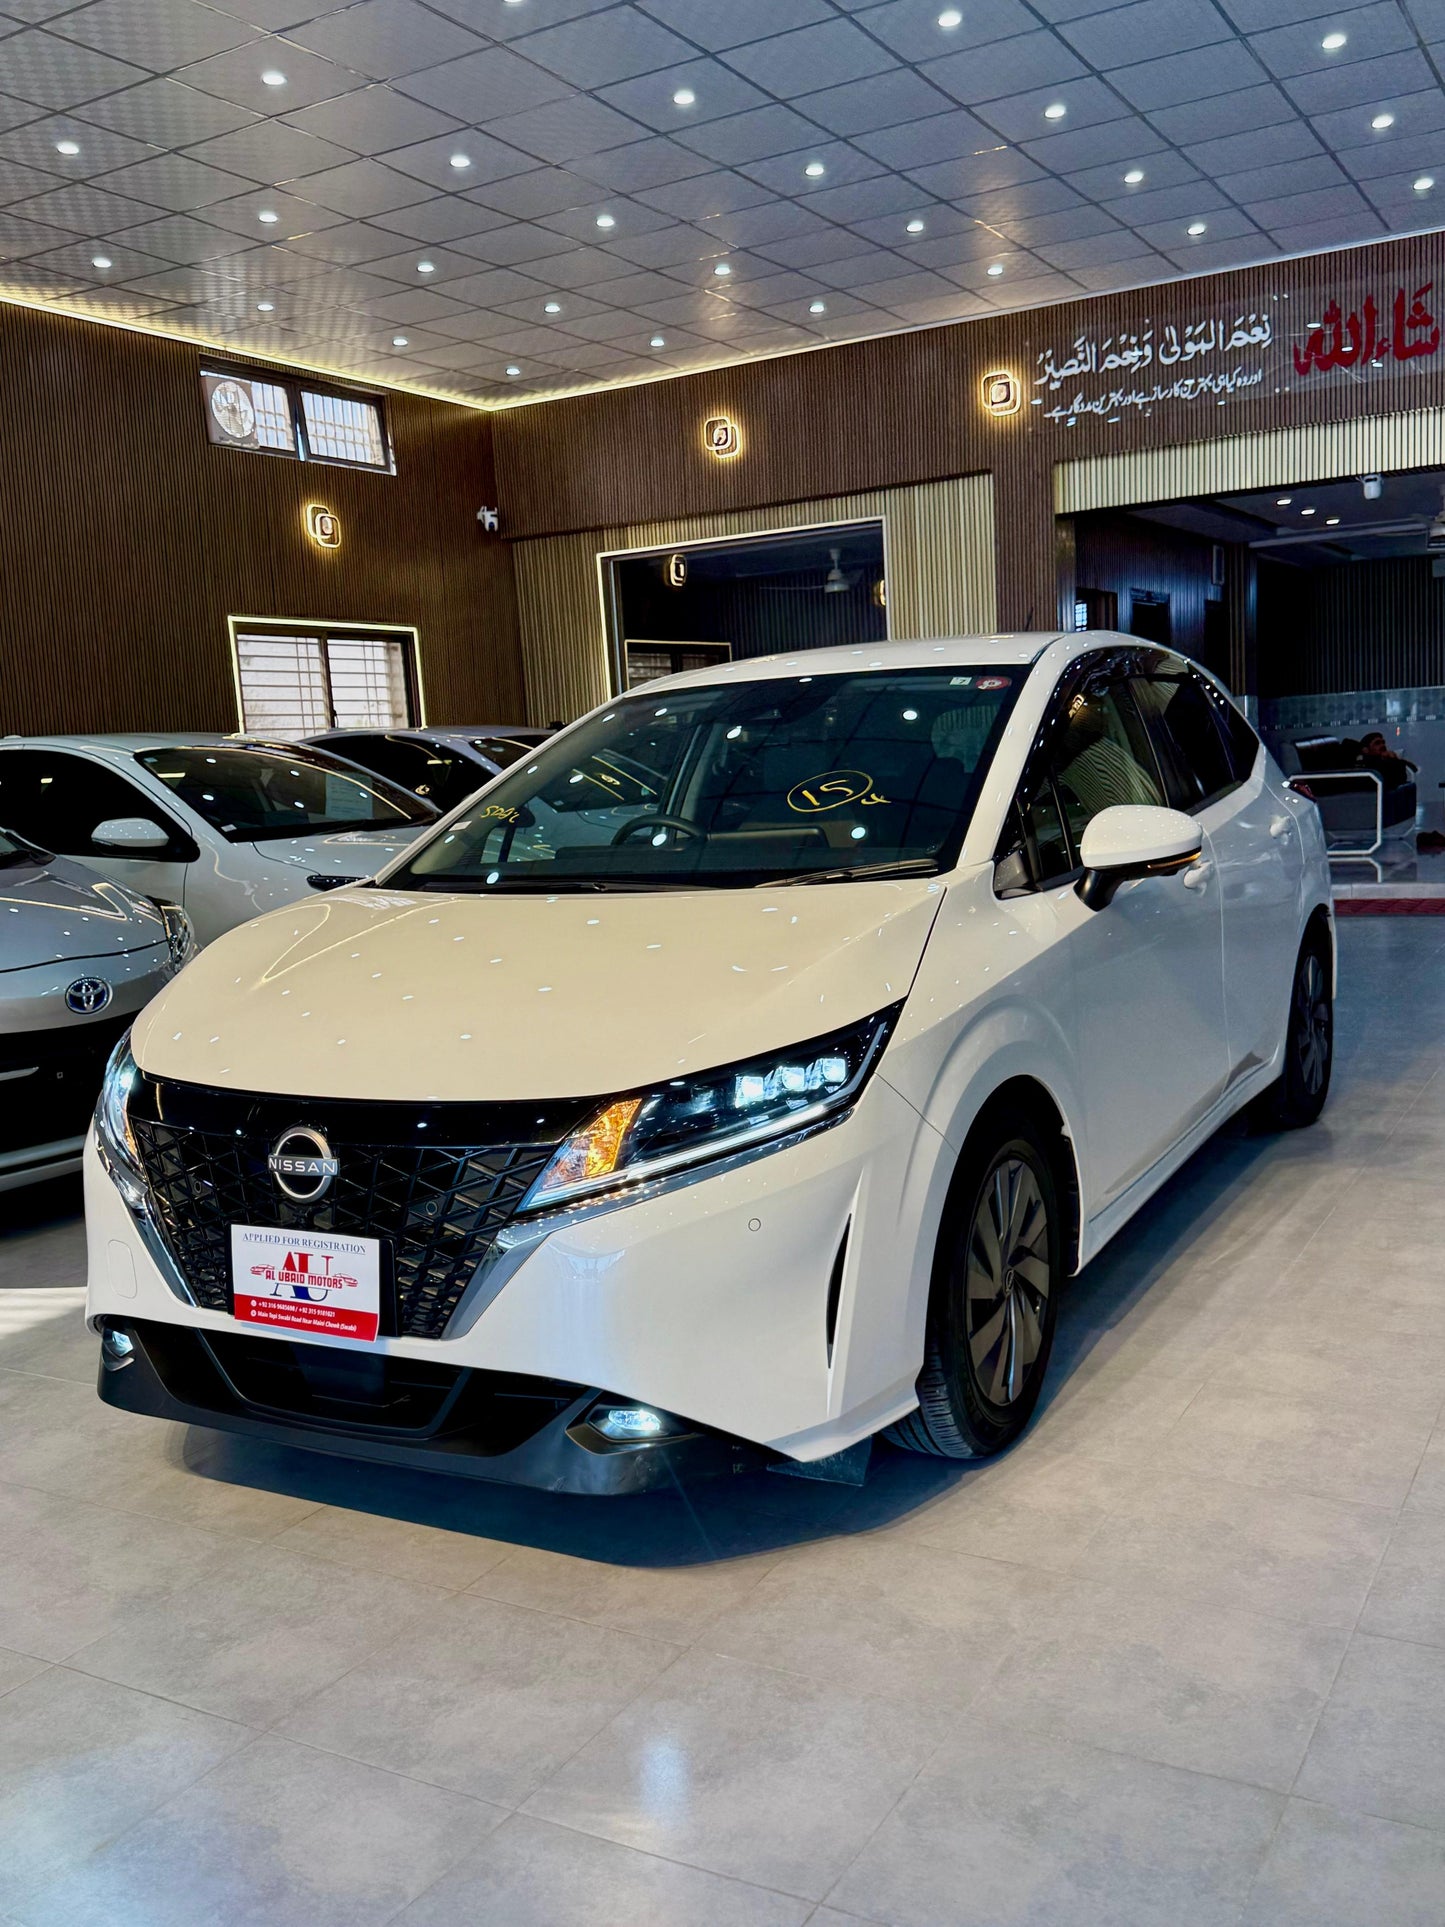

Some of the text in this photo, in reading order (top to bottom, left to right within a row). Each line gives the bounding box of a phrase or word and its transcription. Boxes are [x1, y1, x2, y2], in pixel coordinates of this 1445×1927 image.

[268, 1157, 335, 1174] NISSAN
[243, 1233, 367, 1254] APPLIED FOR REGISTRATION
[265, 1270, 344, 1290] AL UBAID MOTORS
